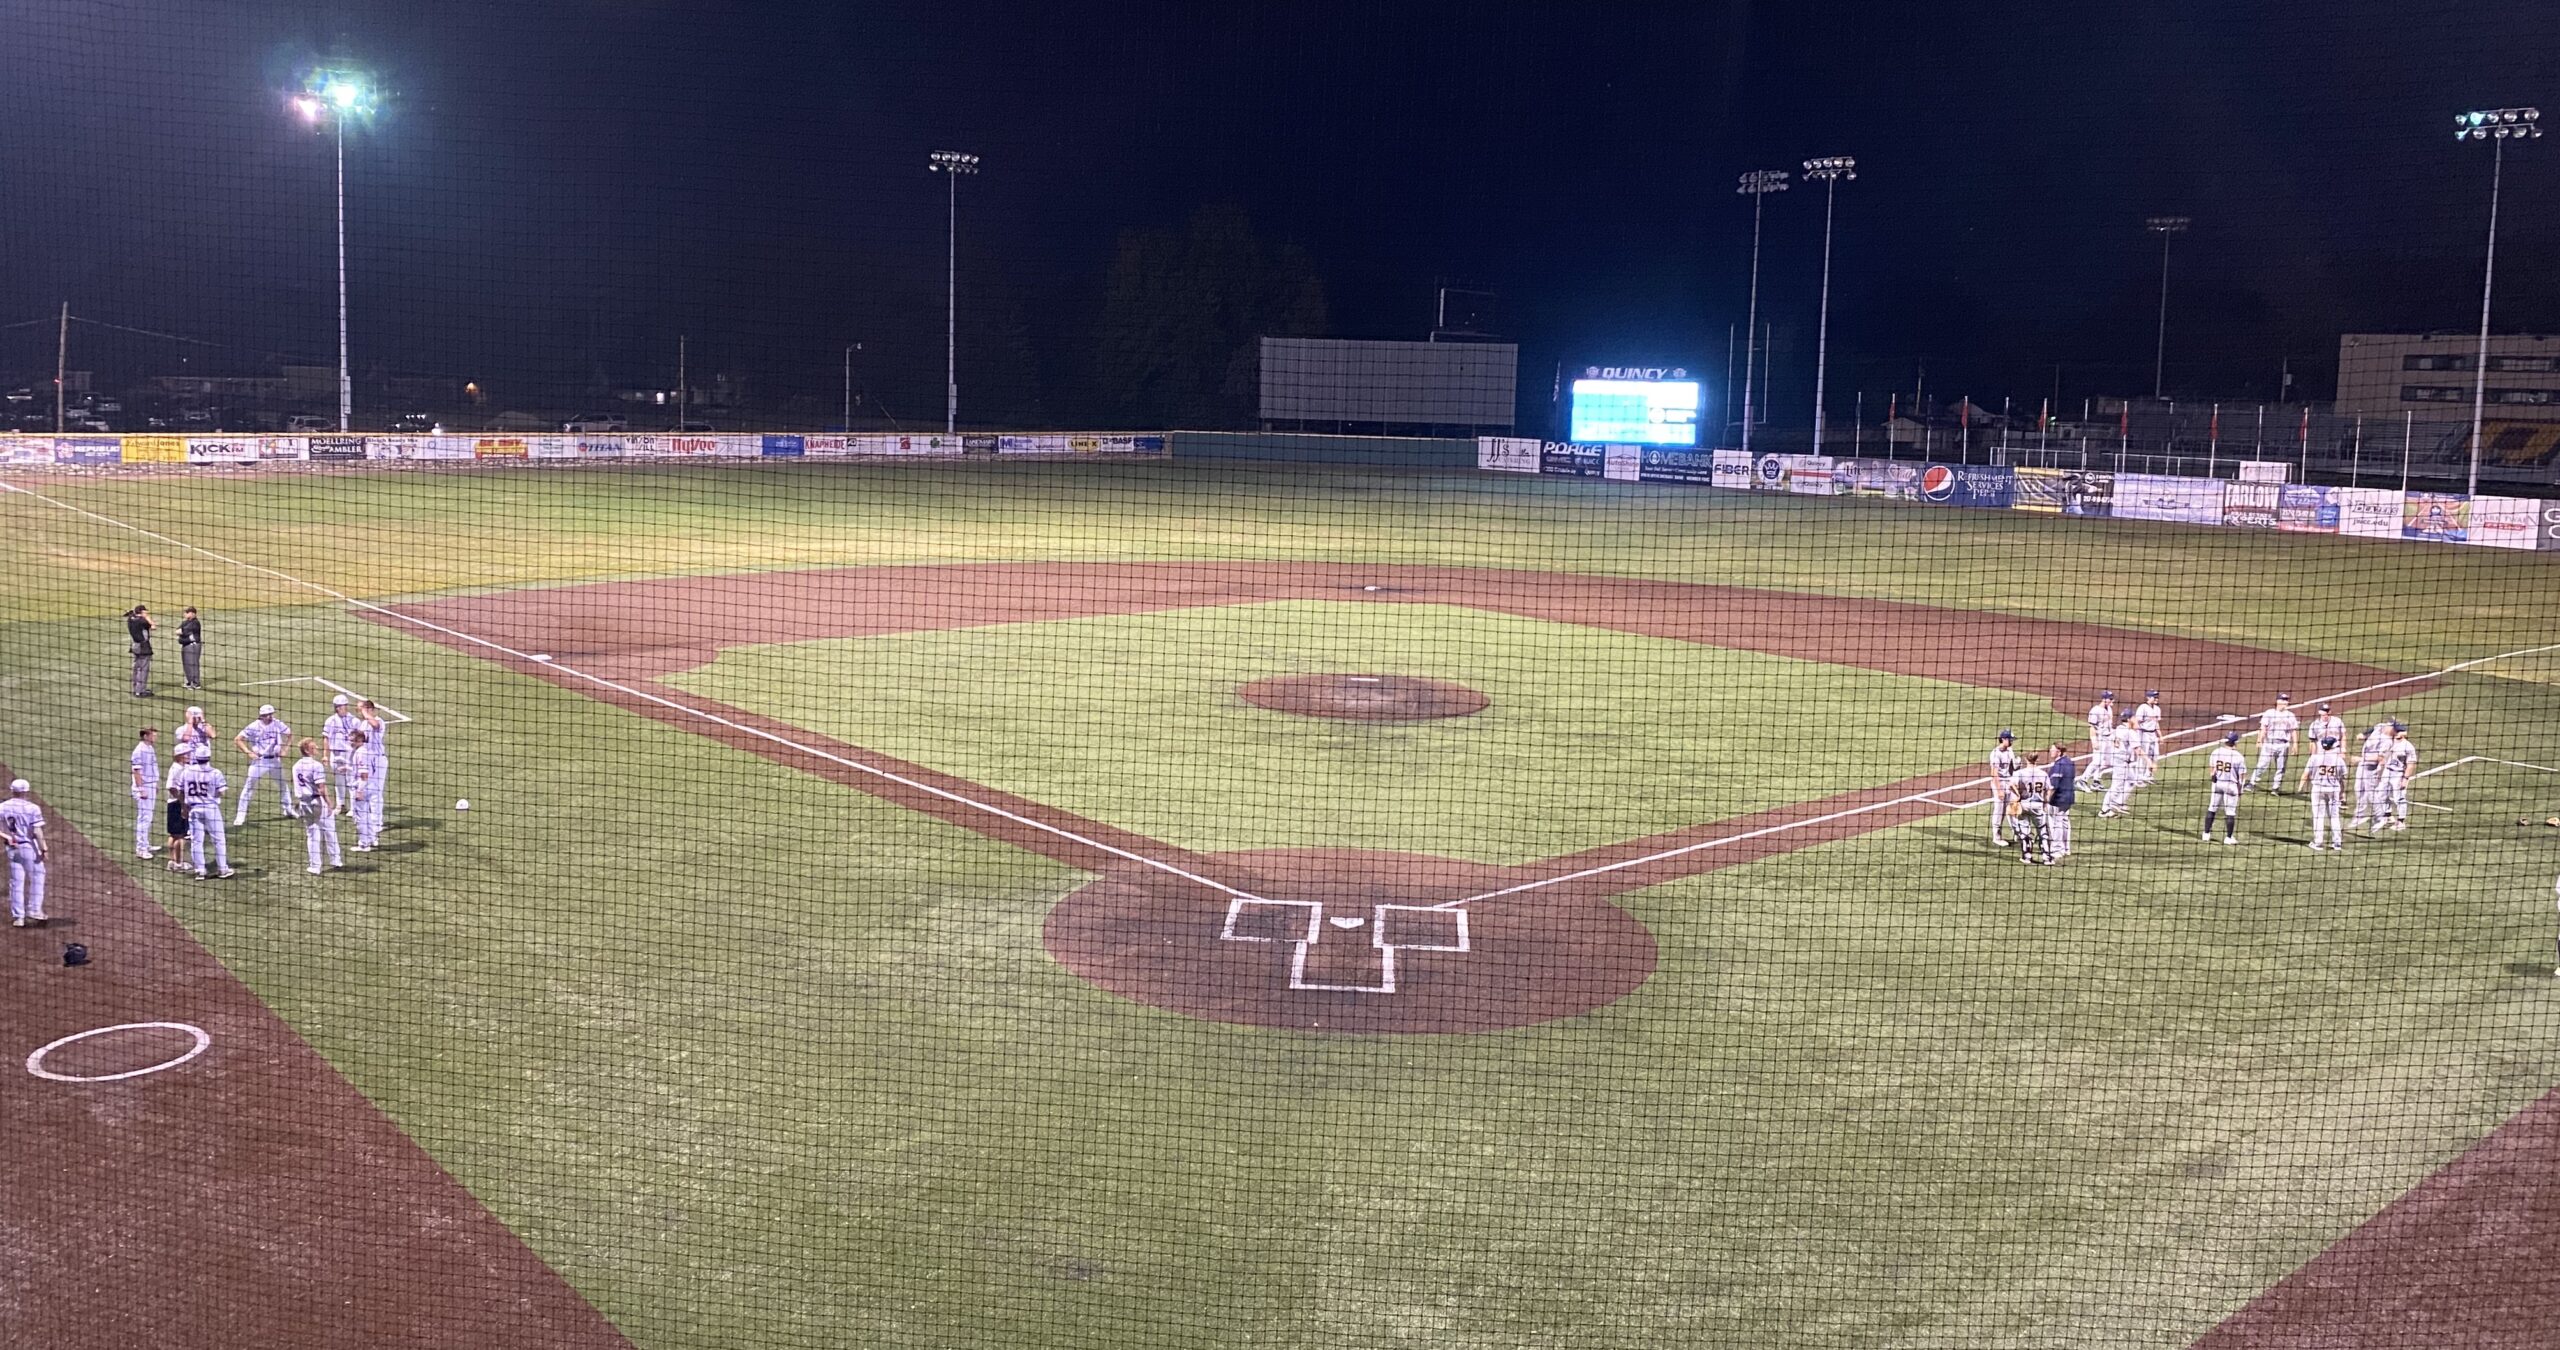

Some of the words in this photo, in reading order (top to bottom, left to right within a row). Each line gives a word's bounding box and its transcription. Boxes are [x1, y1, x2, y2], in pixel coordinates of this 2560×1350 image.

[1602, 367, 1668, 380] QUINCY
[311, 437, 361, 445] MOELLRING
[805, 440, 845, 449] KNAPHEIDE
[190, 444, 230, 456] KICK
[588, 443, 621, 452] TITAN
[1544, 442, 1602, 456] POAGE
[1714, 463, 1749, 475] FIBER
[2224, 483, 2280, 510] FARLOW
[2215, 760, 2232, 773] 28
[2318, 765, 2336, 776] 34
[188, 781, 208, 797] 25
[2026, 782, 2043, 793] 12
